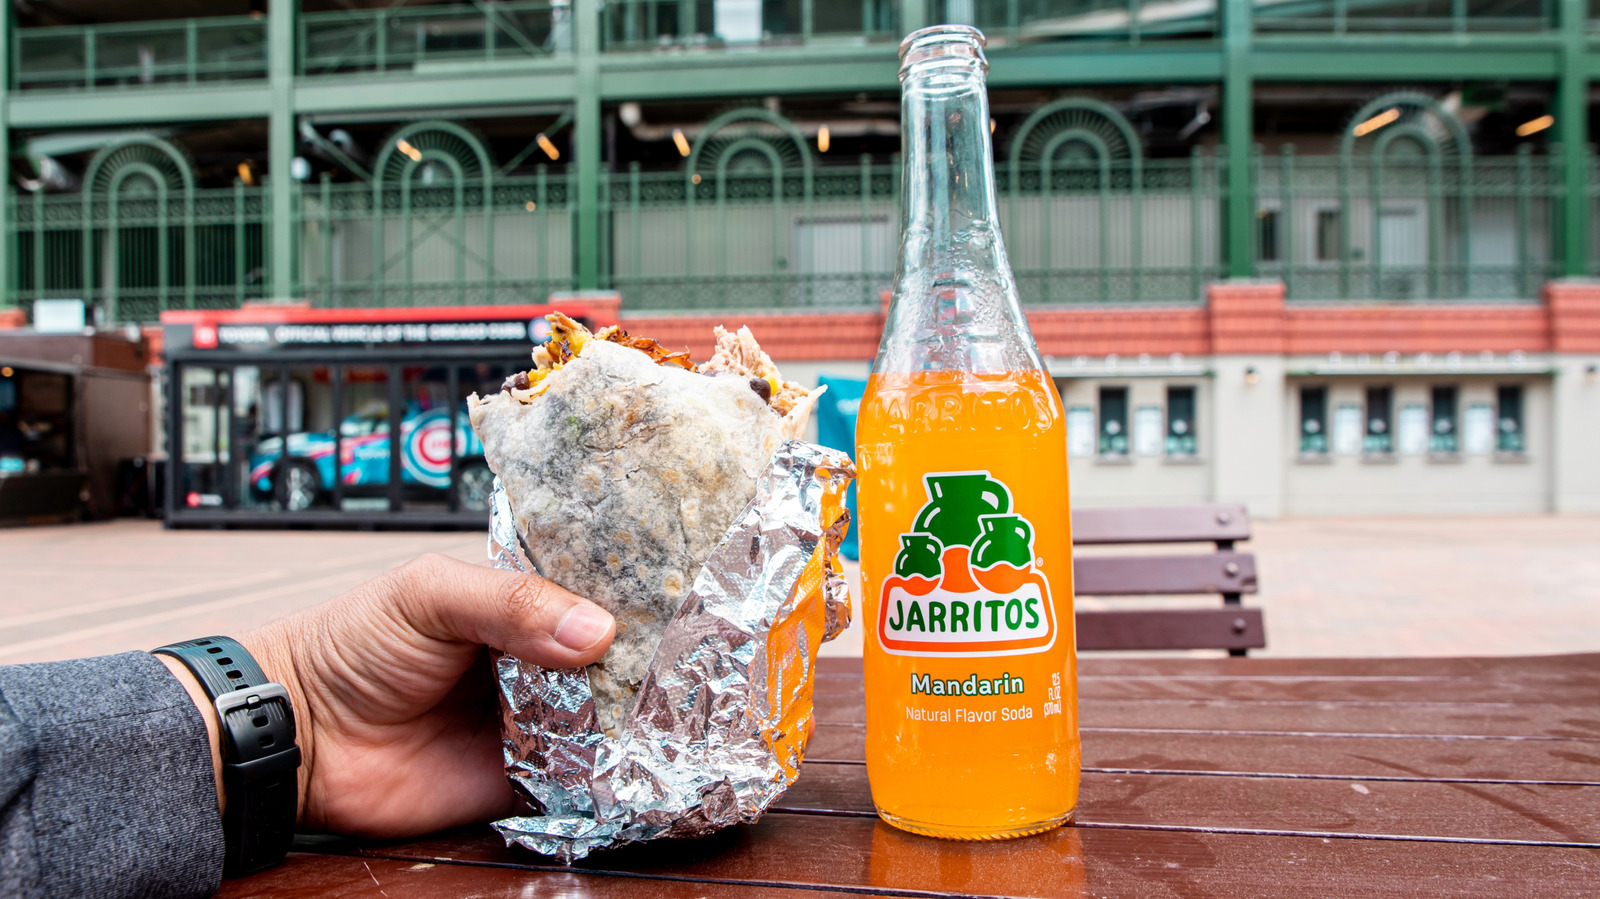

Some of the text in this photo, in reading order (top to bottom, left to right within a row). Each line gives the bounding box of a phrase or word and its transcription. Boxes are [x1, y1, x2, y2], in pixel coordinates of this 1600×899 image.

[889, 598, 1040, 633] JARRITOS
[911, 672, 1025, 696] Mandarin
[1054, 685, 1062, 700] OZ
[906, 706, 1033, 723] Natural Flavor Soda
